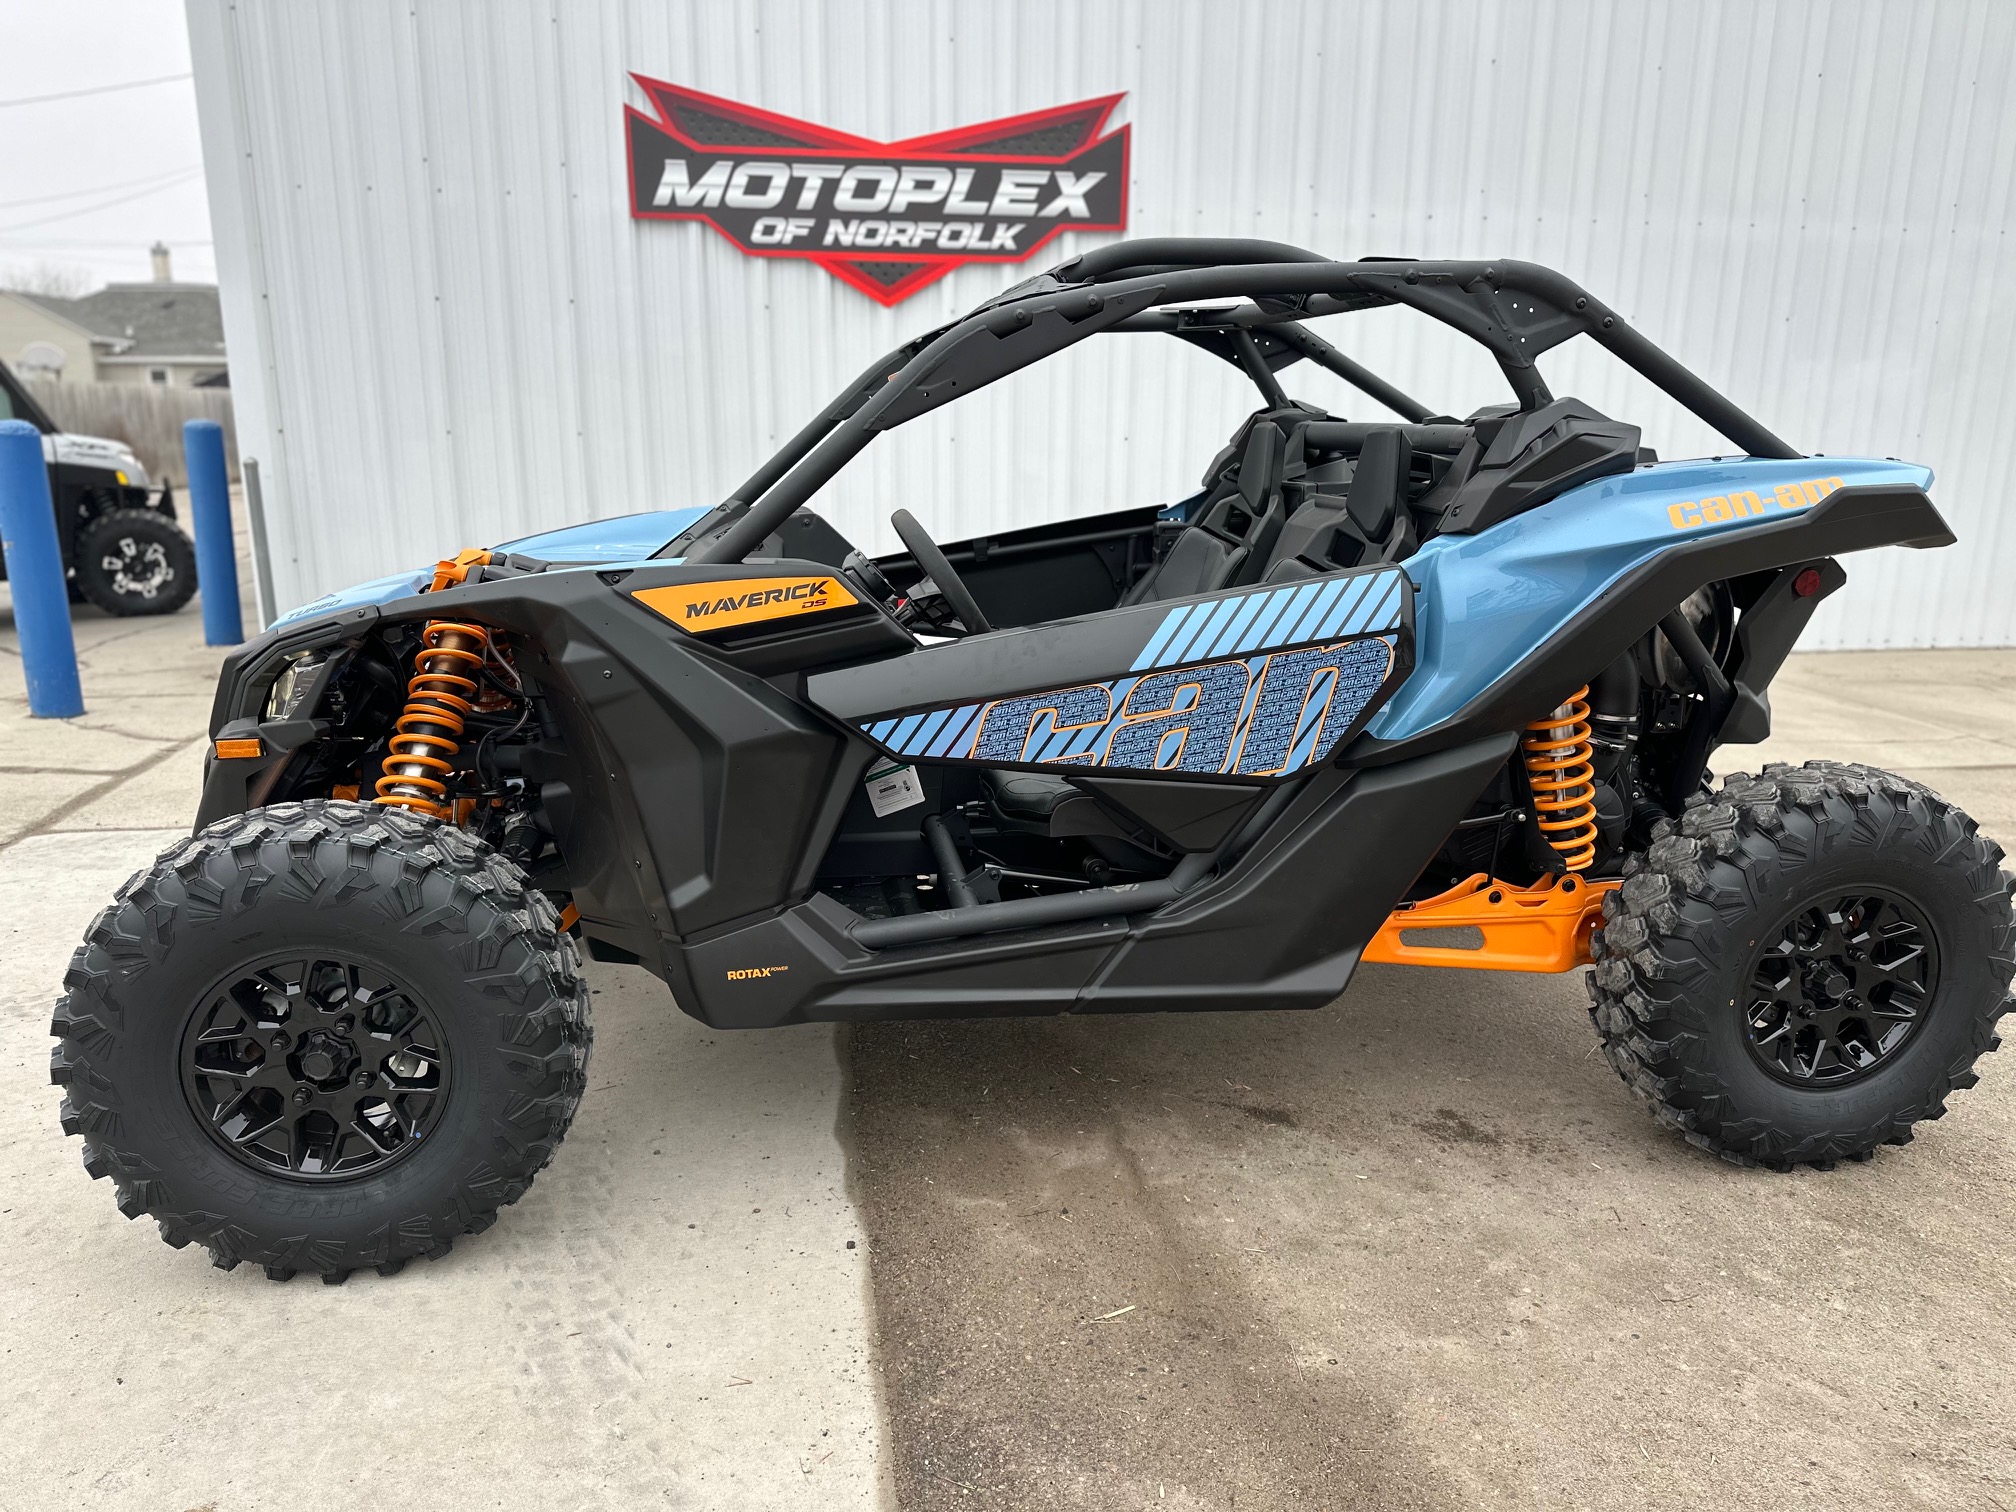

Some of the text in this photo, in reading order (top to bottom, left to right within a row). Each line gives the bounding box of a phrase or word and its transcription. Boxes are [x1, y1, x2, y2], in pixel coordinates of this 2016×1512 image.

[653, 159, 1107, 217] MOTOPLEX
[750, 216, 1027, 250] OF NORFOLK
[288, 598, 343, 619] TURBO
[685, 580, 829, 619] MAVERICK
[801, 598, 828, 609] DS
[727, 967, 771, 980] ROTAX
